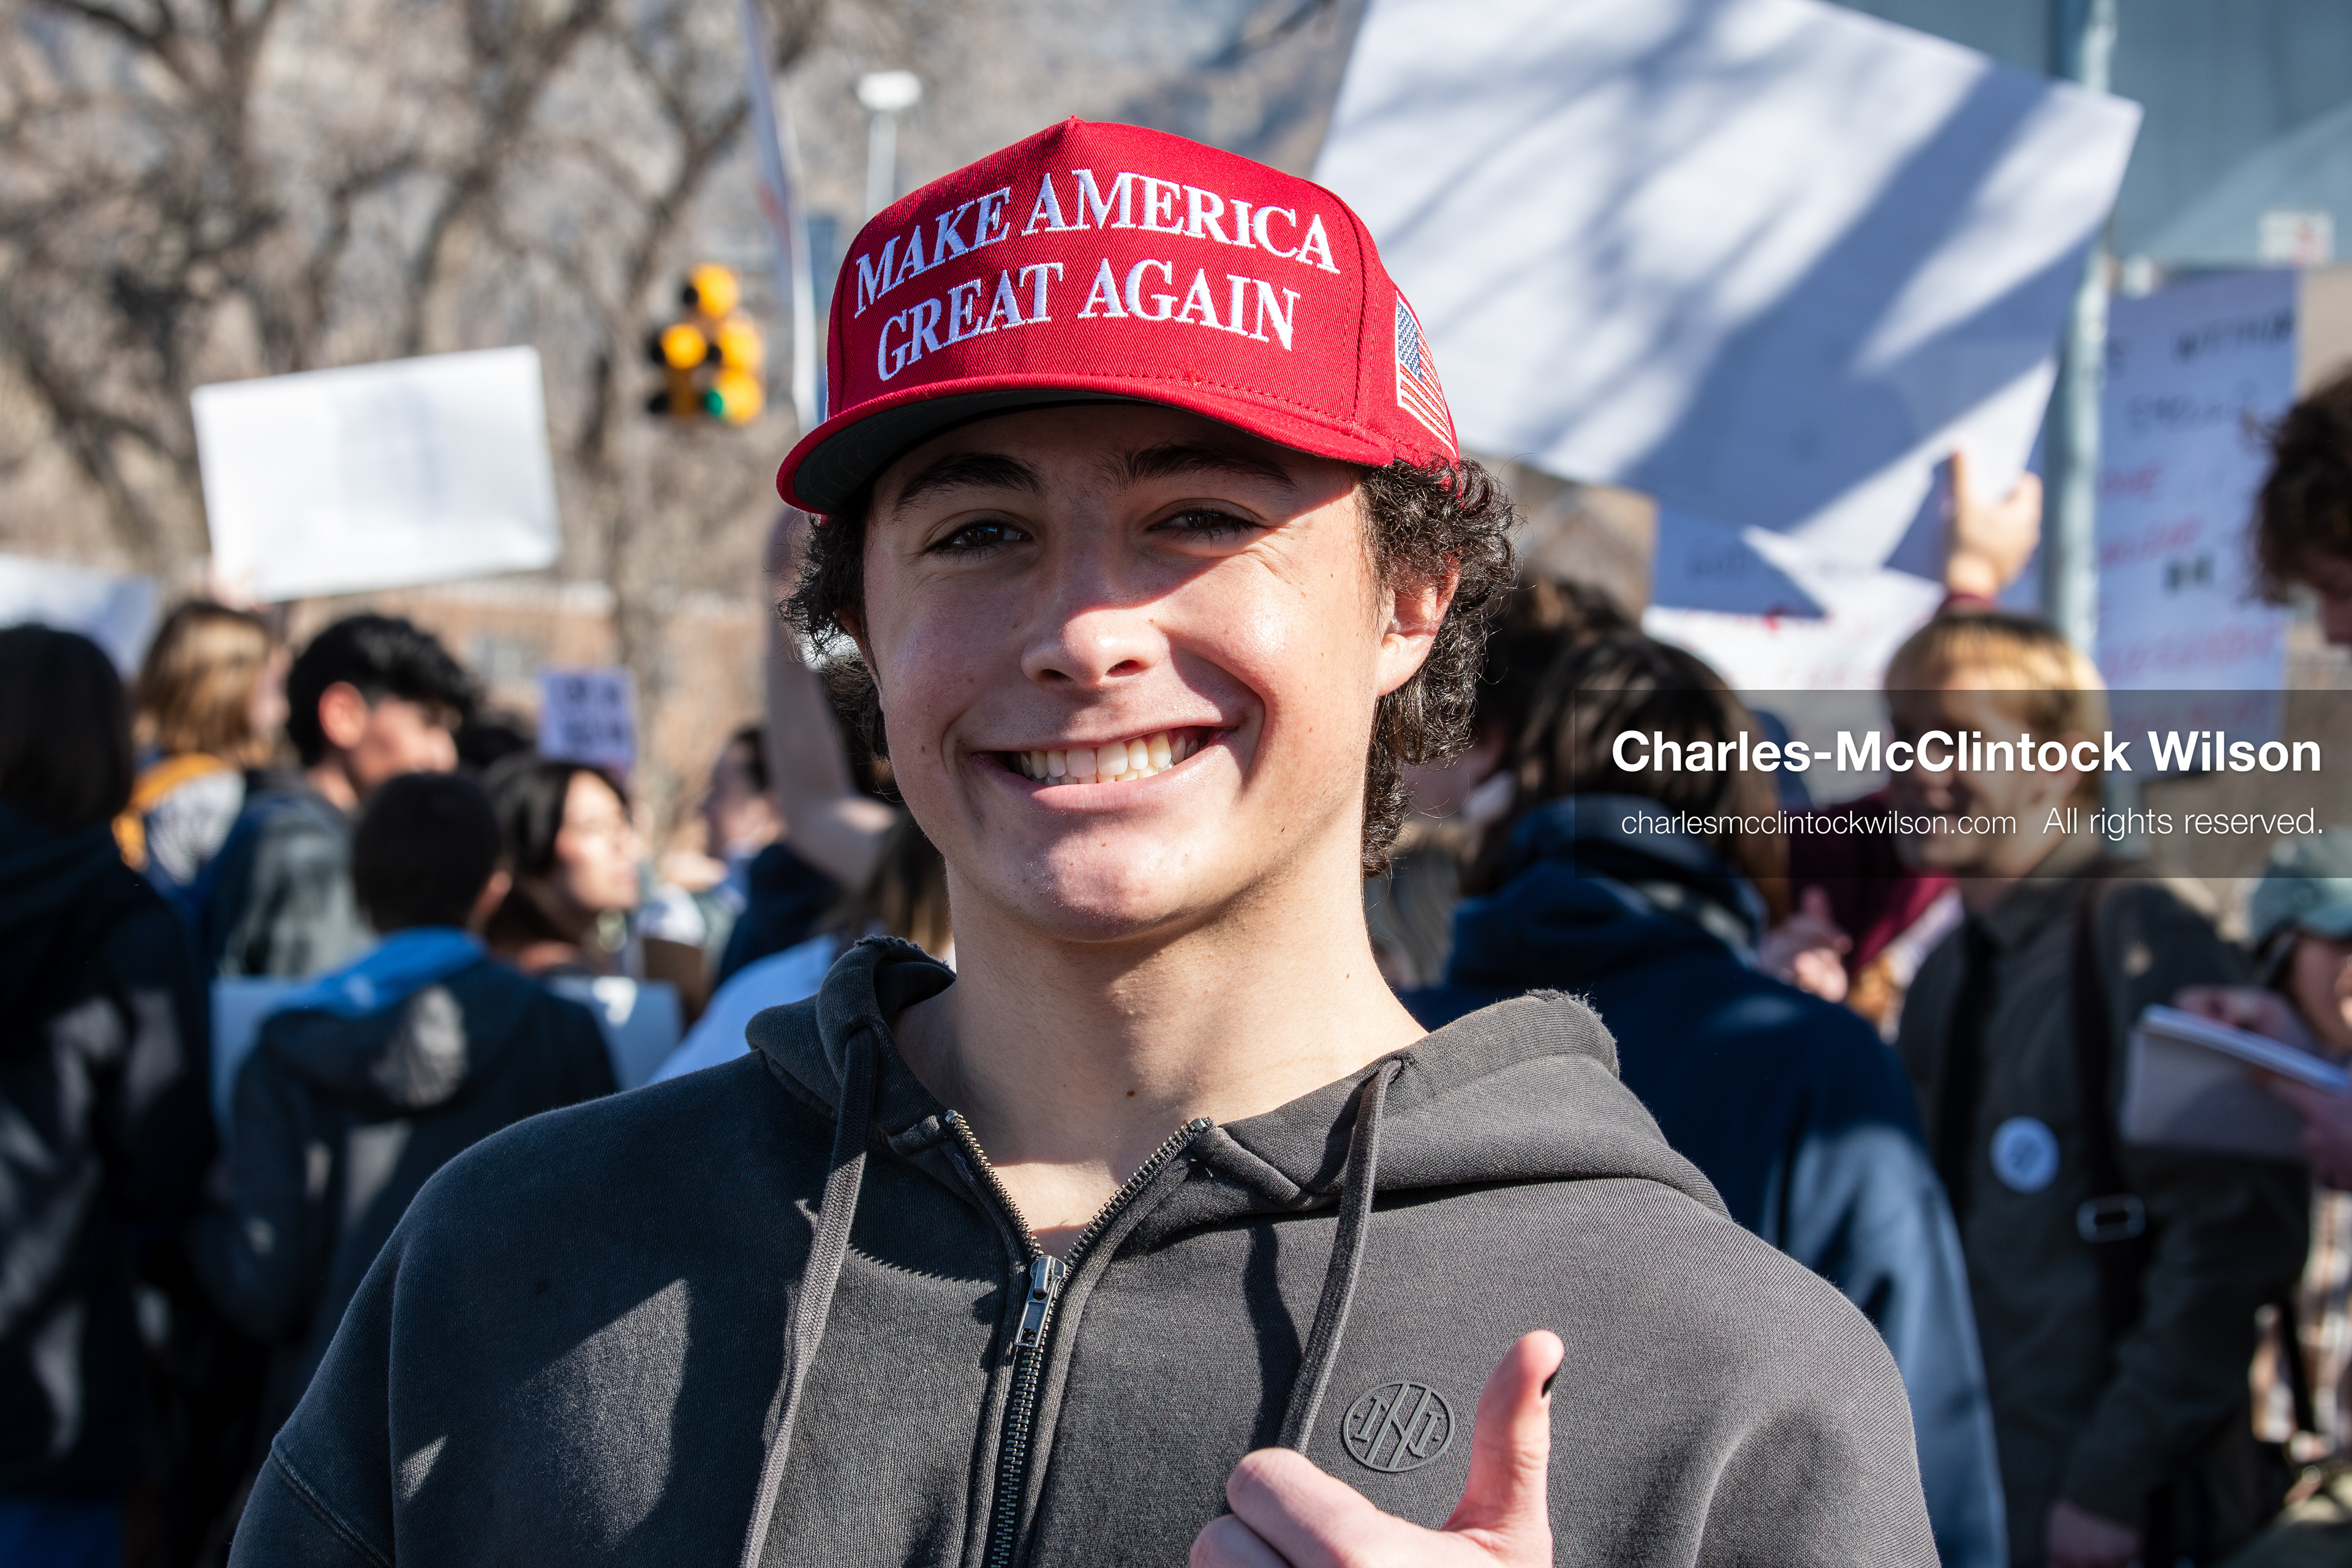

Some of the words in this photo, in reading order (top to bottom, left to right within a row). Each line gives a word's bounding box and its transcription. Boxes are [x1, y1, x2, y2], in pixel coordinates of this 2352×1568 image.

[854, 186, 1011, 319] MAKE
[1020, 168, 1341, 274] AMERICA
[877, 262, 1064, 382] GREAT
[1076, 257, 1301, 351] AGAIN
